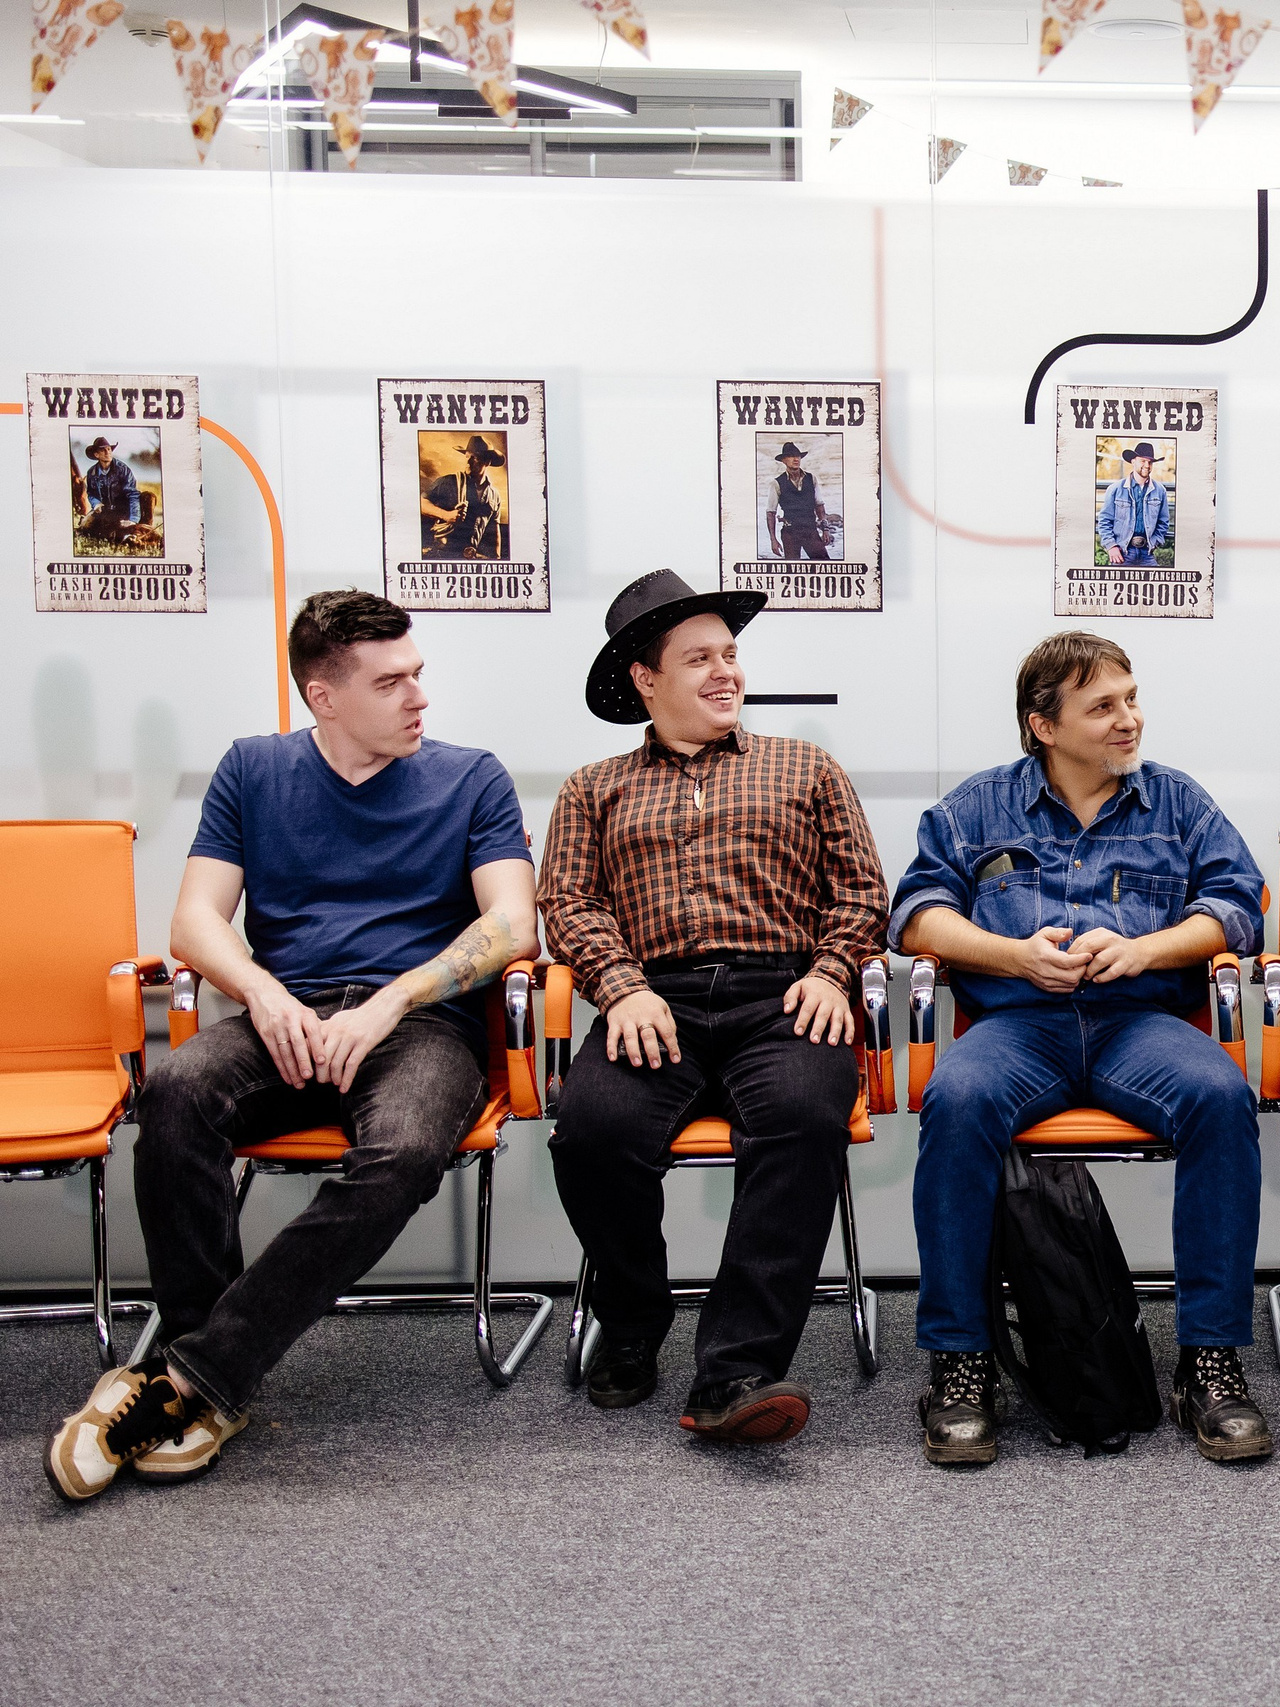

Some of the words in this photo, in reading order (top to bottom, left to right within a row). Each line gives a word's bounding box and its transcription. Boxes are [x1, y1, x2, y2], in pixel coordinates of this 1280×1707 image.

[41, 386, 185, 420] WANTED
[393, 393, 530, 424] WANTED
[732, 395, 866, 426] WANTED
[1070, 398, 1204, 431] WANTED
[53, 564, 84, 574] ARMED
[87, 564, 105, 574] AND
[109, 565, 133, 574] VERY
[136, 564, 187, 575] DANGEROUS
[403, 563, 432, 573] ARMED
[436, 563, 453, 573] AND
[456, 564, 478, 573] VERY
[481, 563, 530, 574] DANGEROUS
[740, 563, 768, 573] ARMED
[771, 563, 787, 573] AND
[790, 564, 811, 573] VERY
[815, 563, 863, 574] DANGEROUS
[1072, 569, 1100, 580] ARMED
[1104, 570, 1120, 580] AND
[1124, 571, 1146, 580] VERY
[1148, 571, 1197, 582] DANGEROUS
[50, 577, 92, 591] CASH
[98, 577, 190, 601] 20000$
[50, 593, 93, 601] REWARD
[400, 576, 440, 590] CASH
[446, 576, 533, 599] 20000$
[400, 591, 441, 599] REWARD
[735, 576, 775, 590] CASH
[780, 576, 865, 599] 20000$
[1068, 582, 1107, 597] CASH
[1113, 582, 1198, 608] 20000$
[1068, 597, 1108, 606] REWARD
